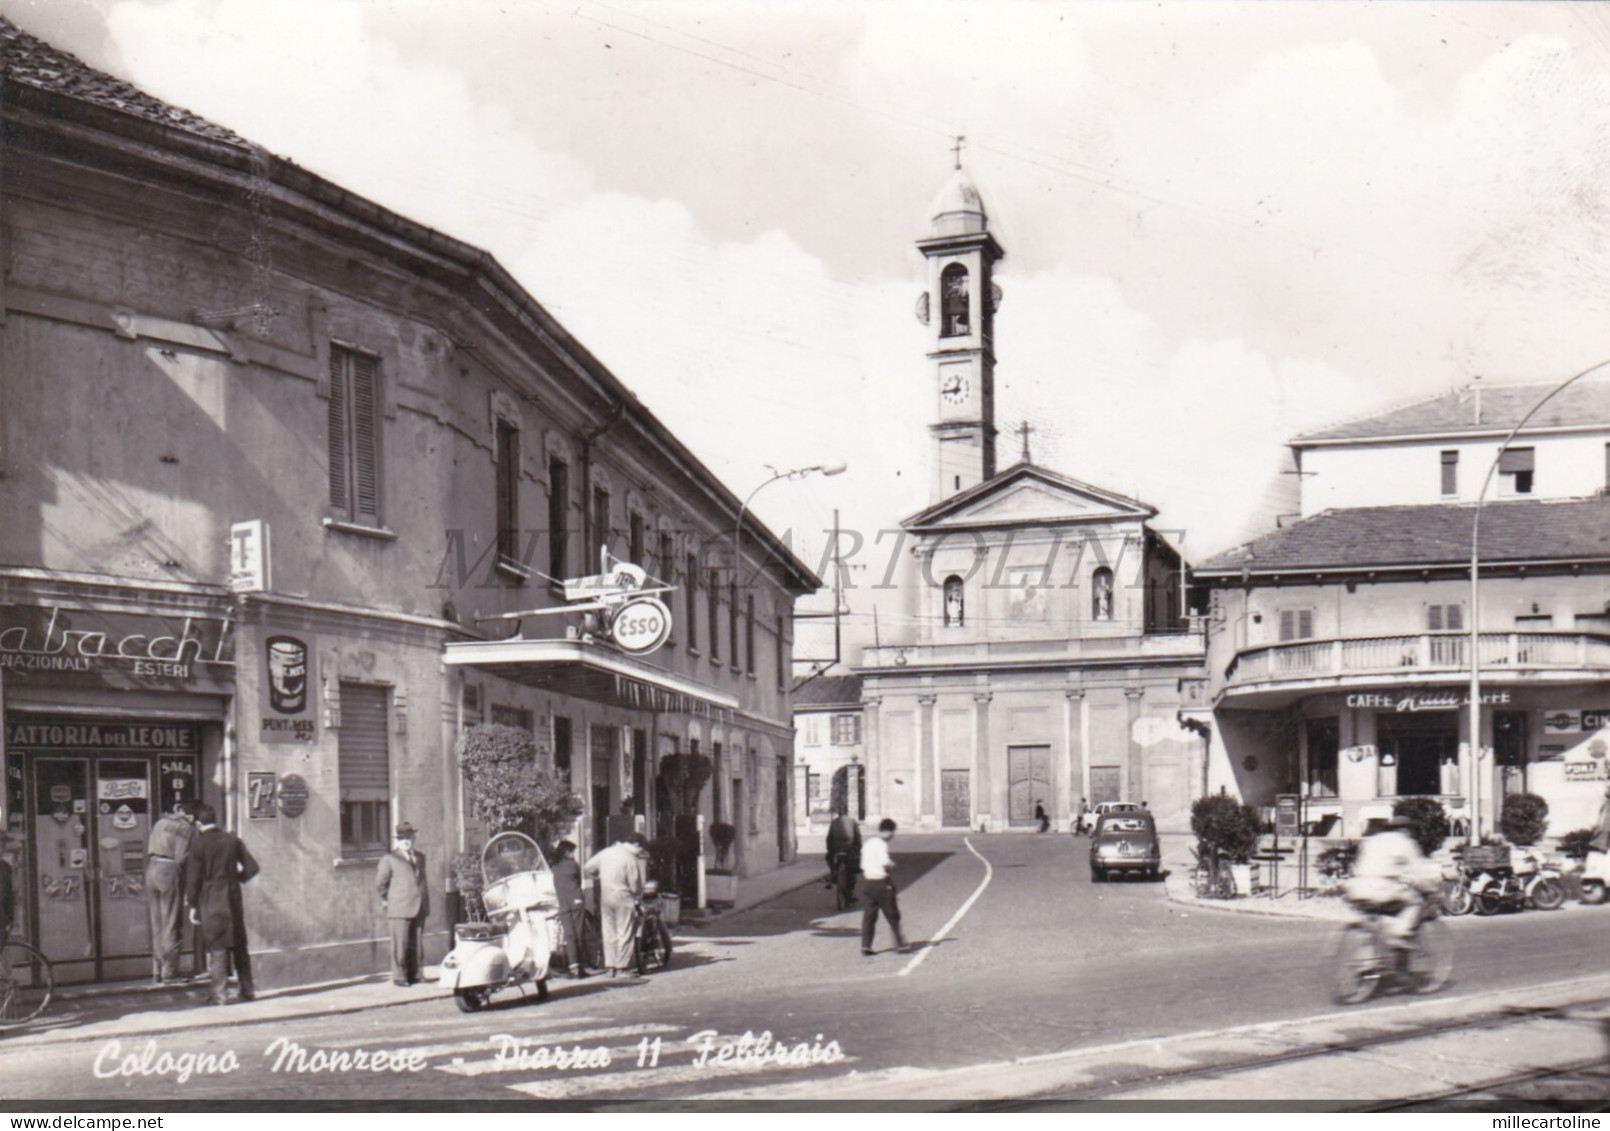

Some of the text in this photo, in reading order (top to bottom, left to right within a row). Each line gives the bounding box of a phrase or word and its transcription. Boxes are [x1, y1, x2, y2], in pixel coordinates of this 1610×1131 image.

[1, 653, 189, 677] NAZIONALI ESTERI
[1346, 694, 1394, 708] CAFFE
[104, 733, 128, 746] DEL
[129, 728, 190, 747] LEONE
[161, 762, 193, 775] SALA
